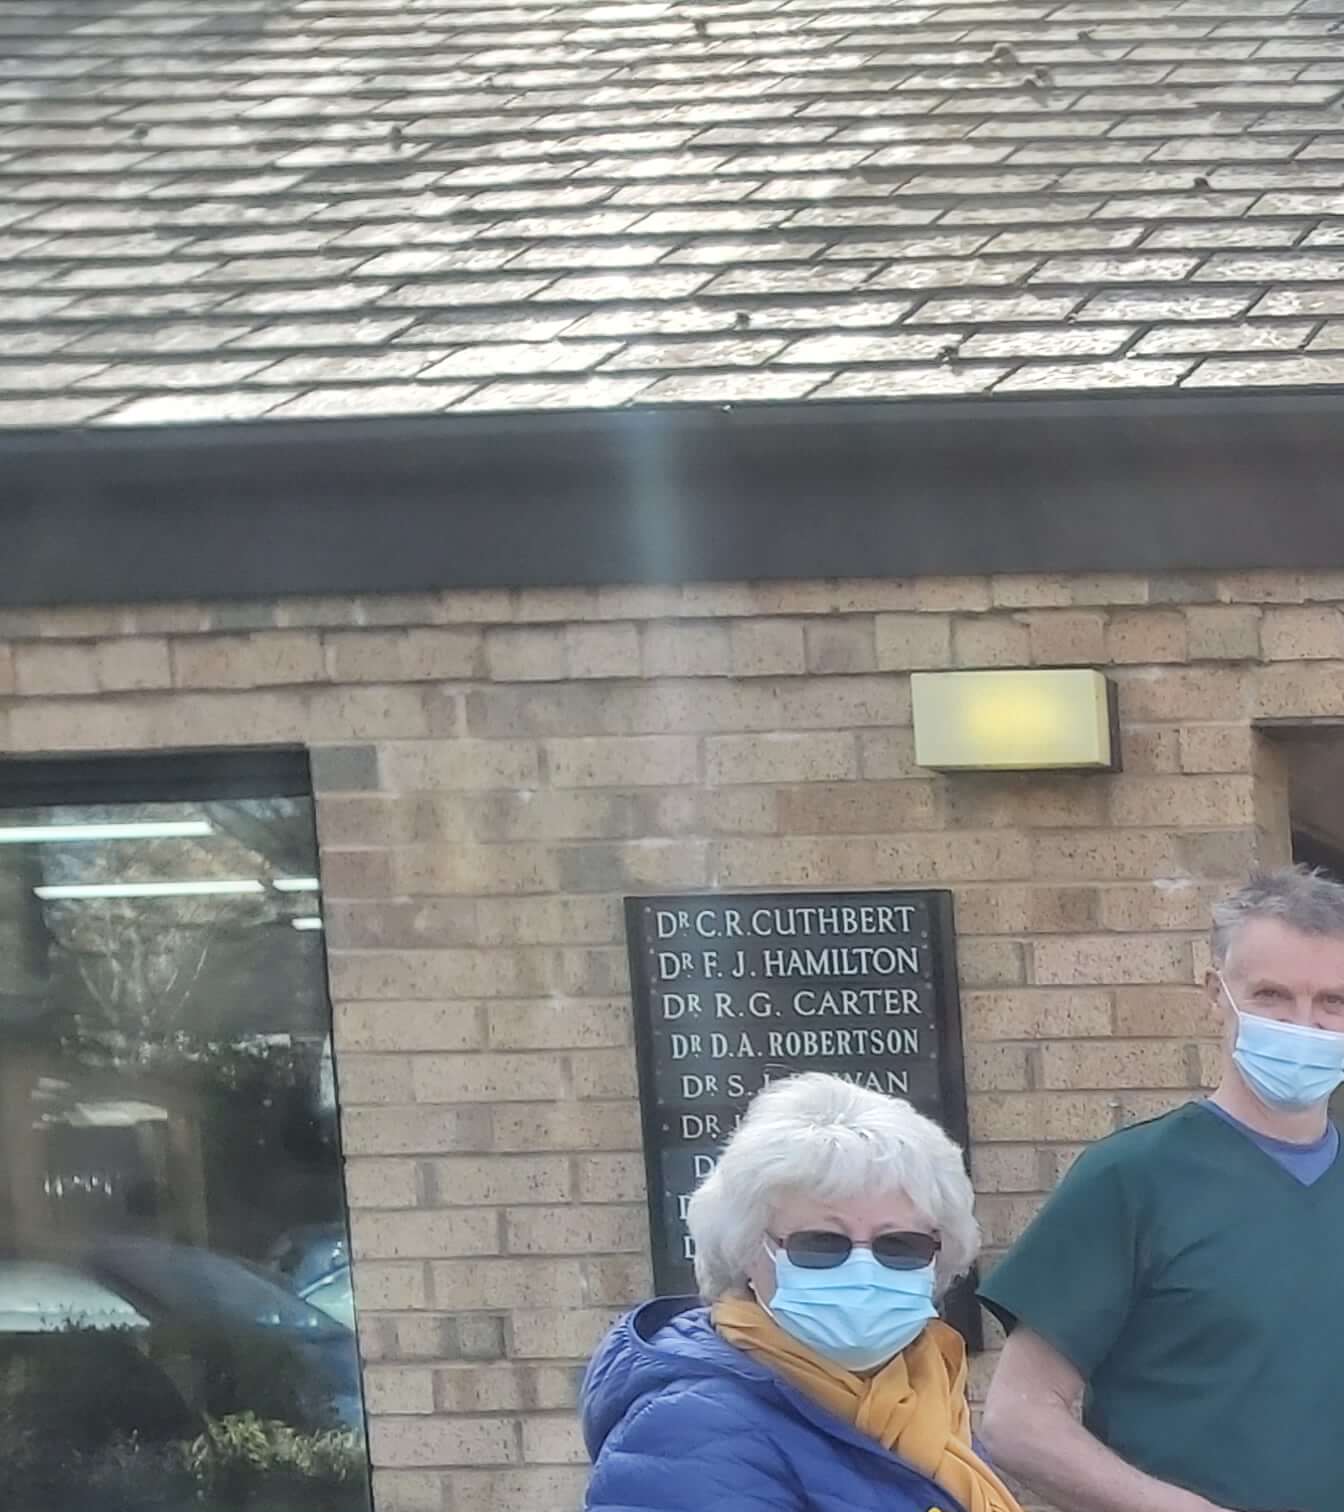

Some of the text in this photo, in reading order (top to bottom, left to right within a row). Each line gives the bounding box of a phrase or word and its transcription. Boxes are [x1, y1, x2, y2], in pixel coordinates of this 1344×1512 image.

[752, 906, 916, 937] CUTHBERT
[763, 947, 920, 978] HAMILTON
[792, 989, 922, 1016] CARTER
[710, 1032, 764, 1059] D.A.
[768, 1028, 920, 1057] ROBERTSON
